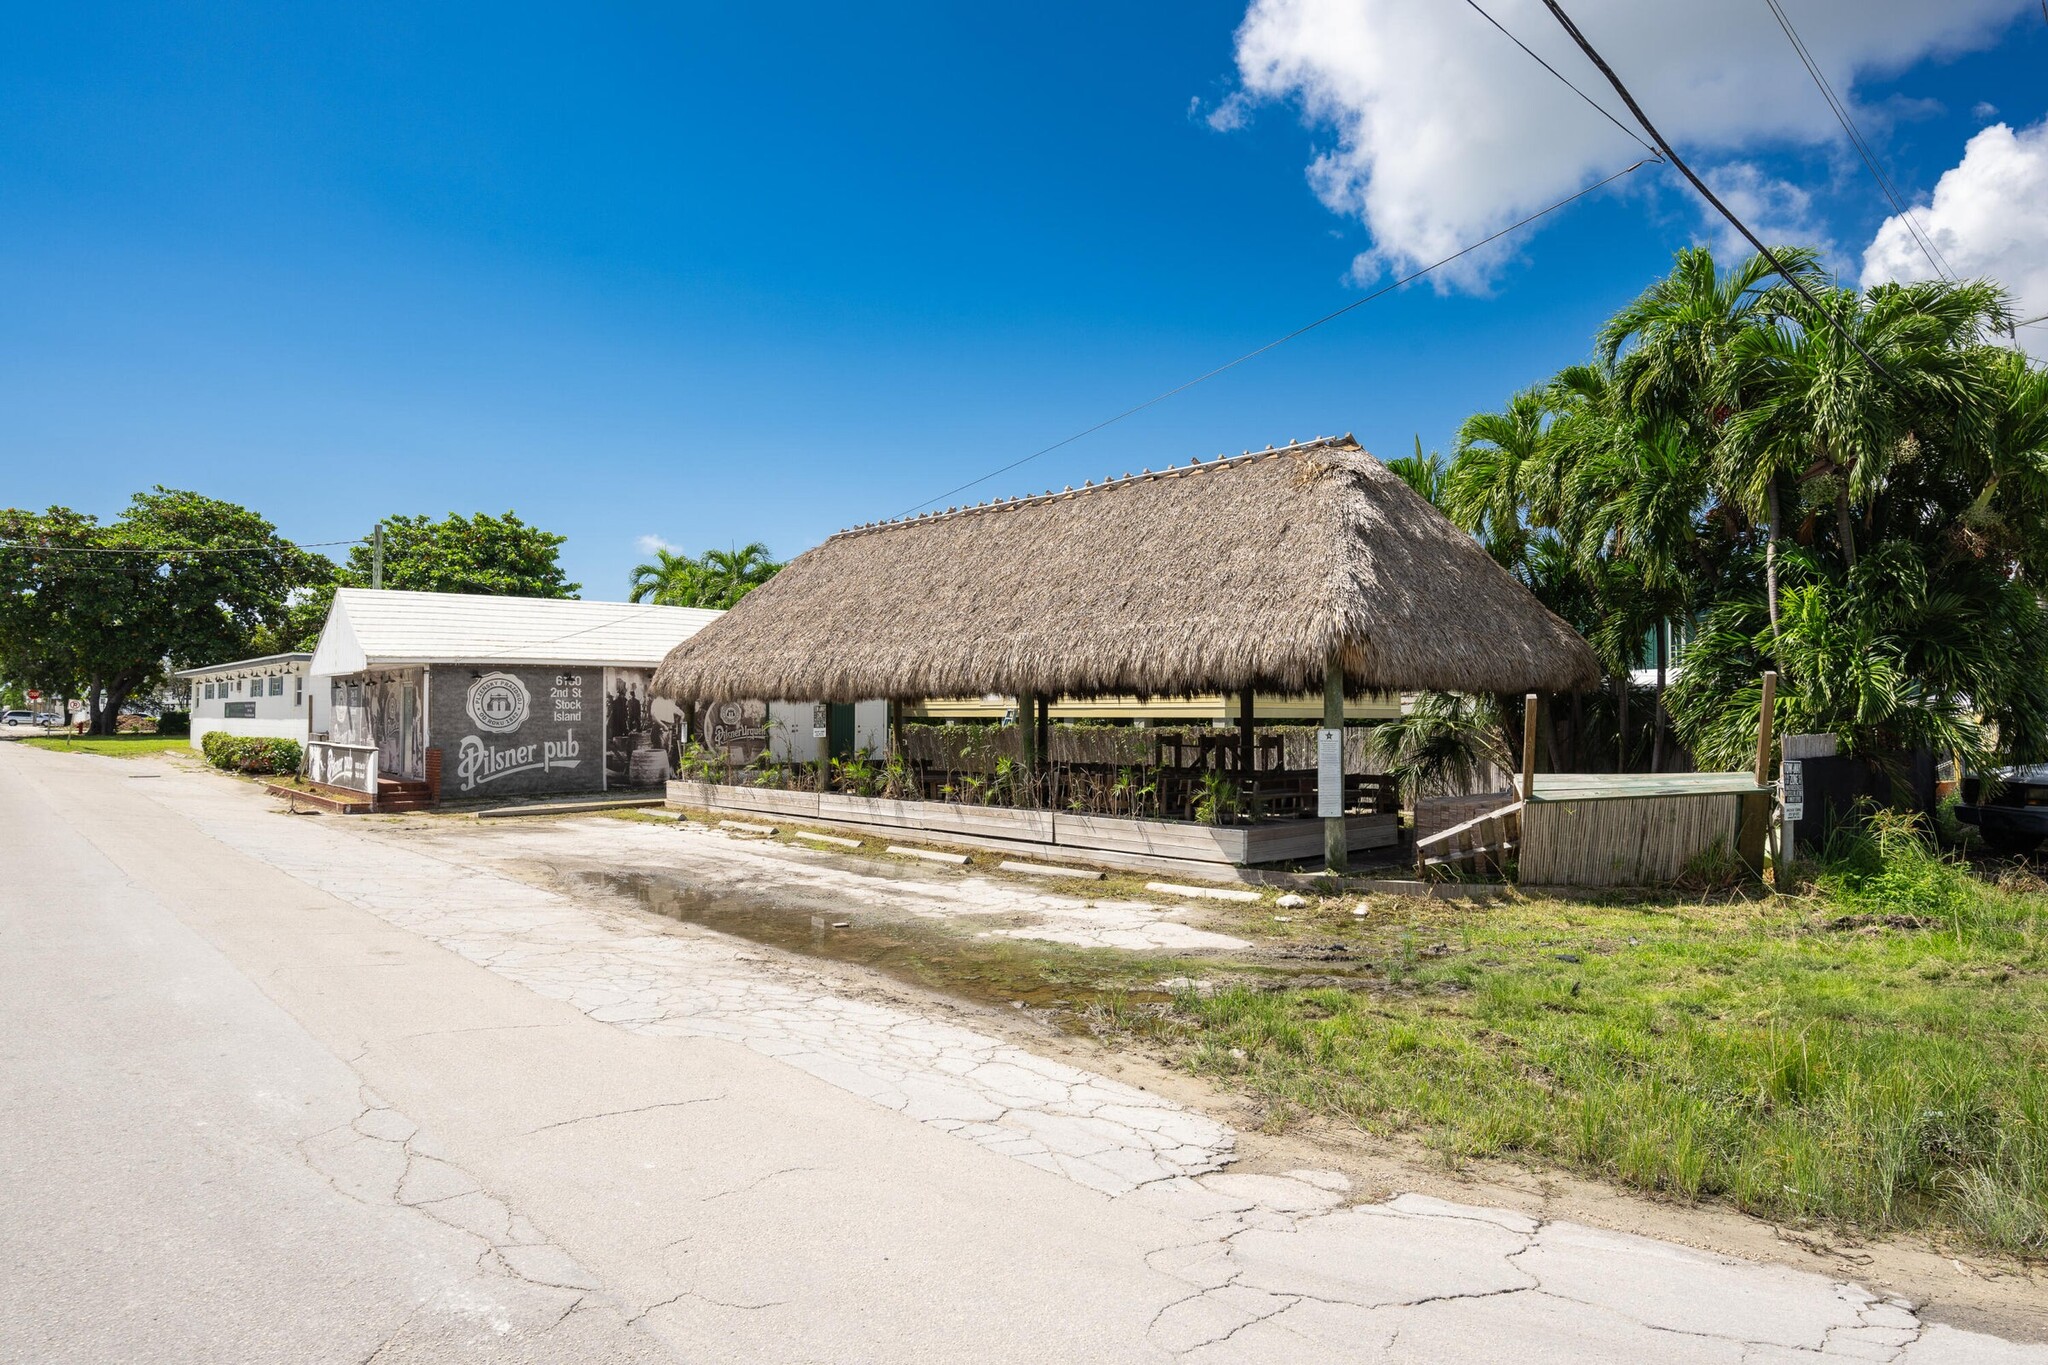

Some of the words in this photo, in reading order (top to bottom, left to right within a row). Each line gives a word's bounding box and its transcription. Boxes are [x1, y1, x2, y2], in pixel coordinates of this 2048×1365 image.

[500, 681, 522, 704] PRAZDROJ
[550, 687, 568, 698] 2nd
[572, 687, 582, 698] St
[555, 699, 581, 710] Stock
[479, 712, 487, 720] OD
[505, 712, 518, 724] 1842
[554, 710, 581, 722] Island
[714, 724, 742, 747] Pilsner
[457, 735, 537, 791] Pilsner
[544, 728, 580, 773] pub
